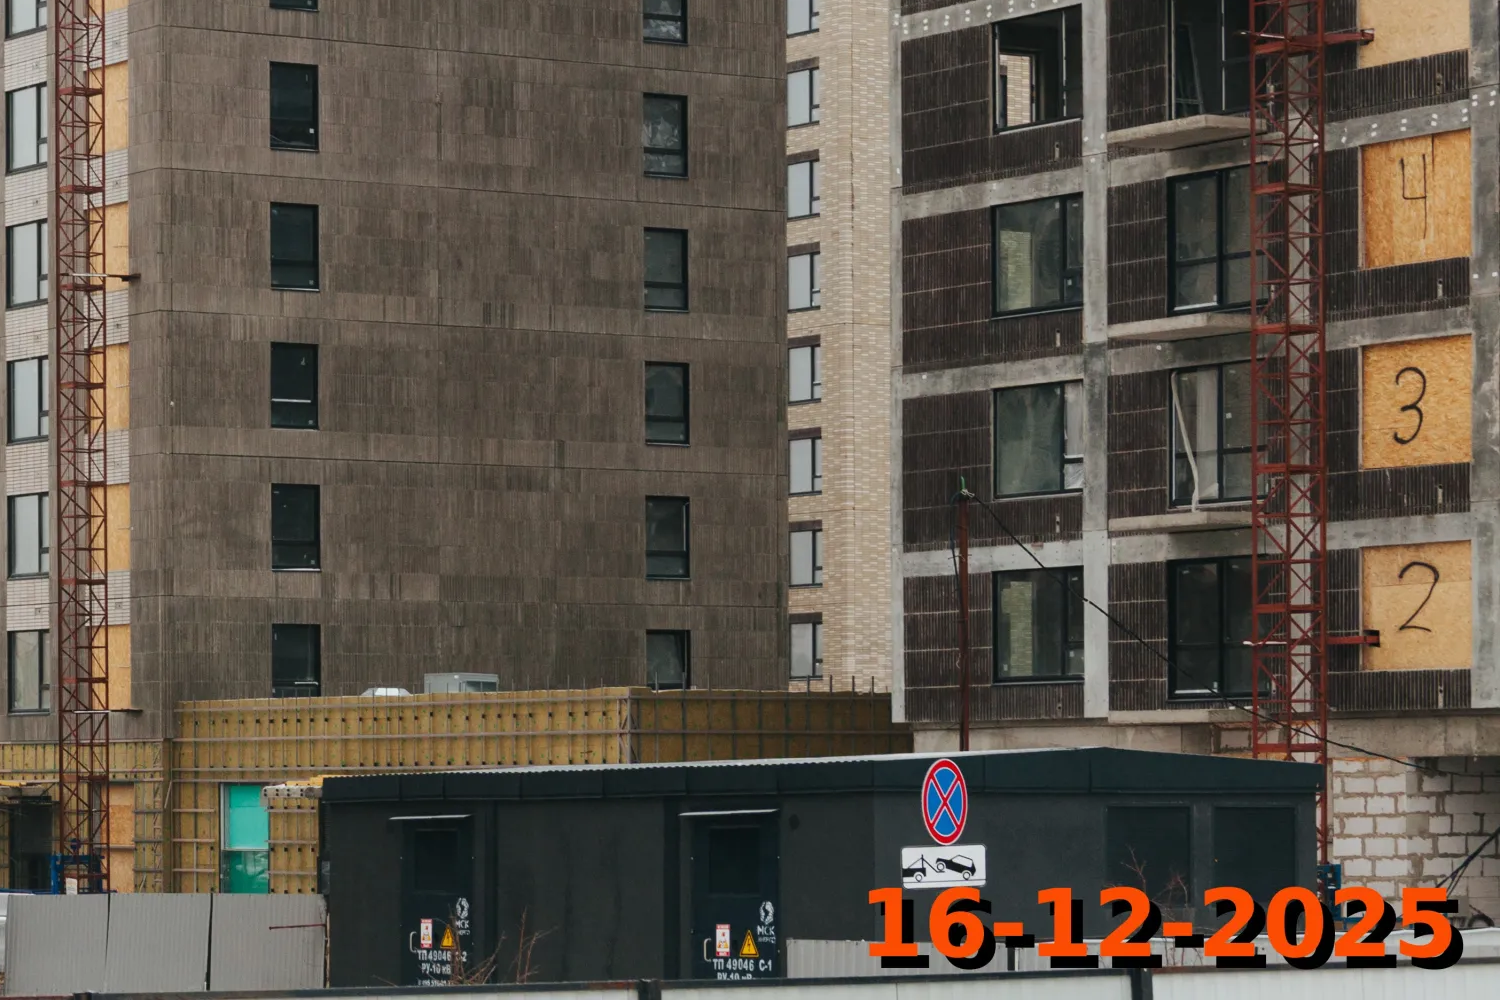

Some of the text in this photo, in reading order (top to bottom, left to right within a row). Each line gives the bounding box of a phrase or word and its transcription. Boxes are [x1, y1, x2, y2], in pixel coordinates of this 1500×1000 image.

[1400, 153, 1427, 240] 4
[1394, 366, 1426, 445] 3
[1398, 561, 1439, 632] 2
[726, 959, 754, 971] 49046
